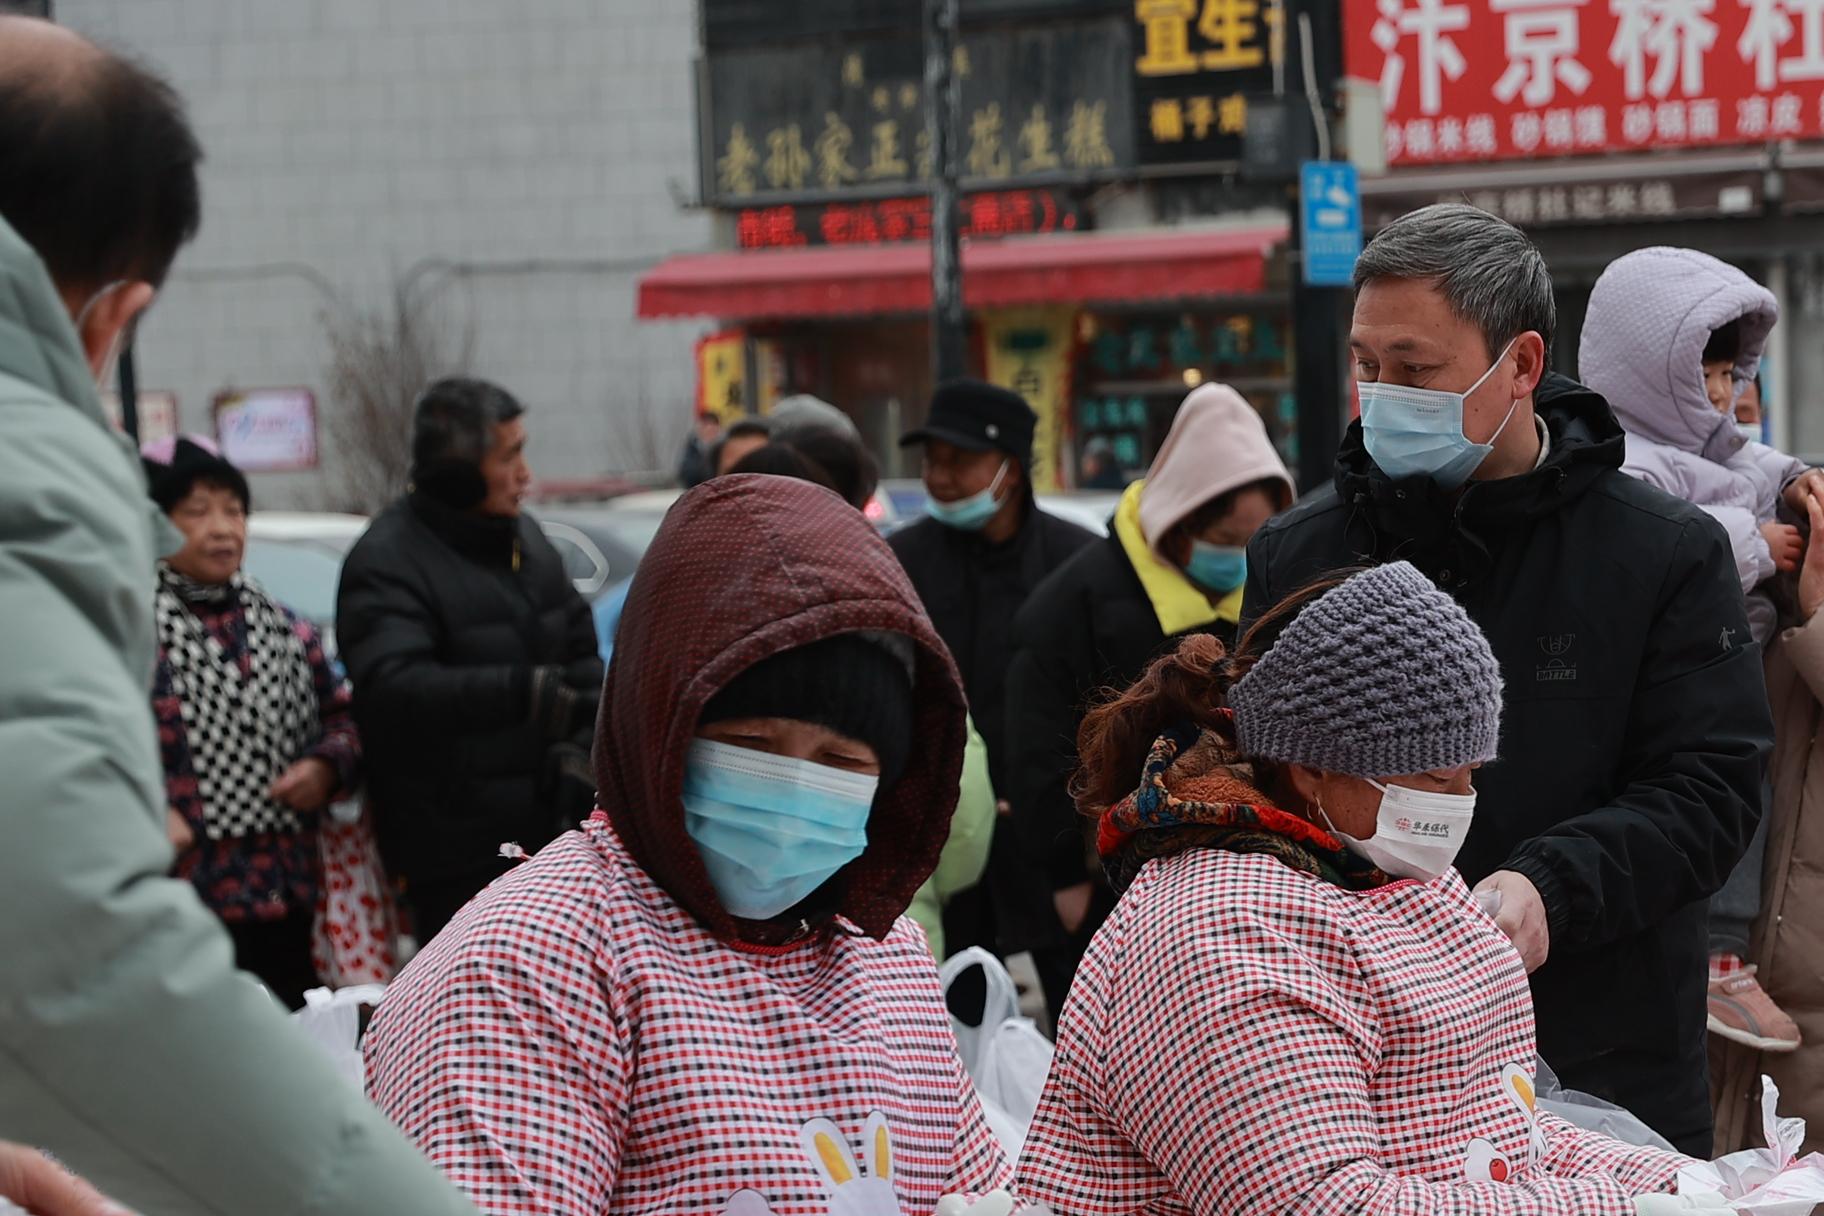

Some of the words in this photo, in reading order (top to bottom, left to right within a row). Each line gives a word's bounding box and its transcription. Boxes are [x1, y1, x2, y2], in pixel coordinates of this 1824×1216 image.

[1438, 180, 1675, 225] 京桥杜记米线
